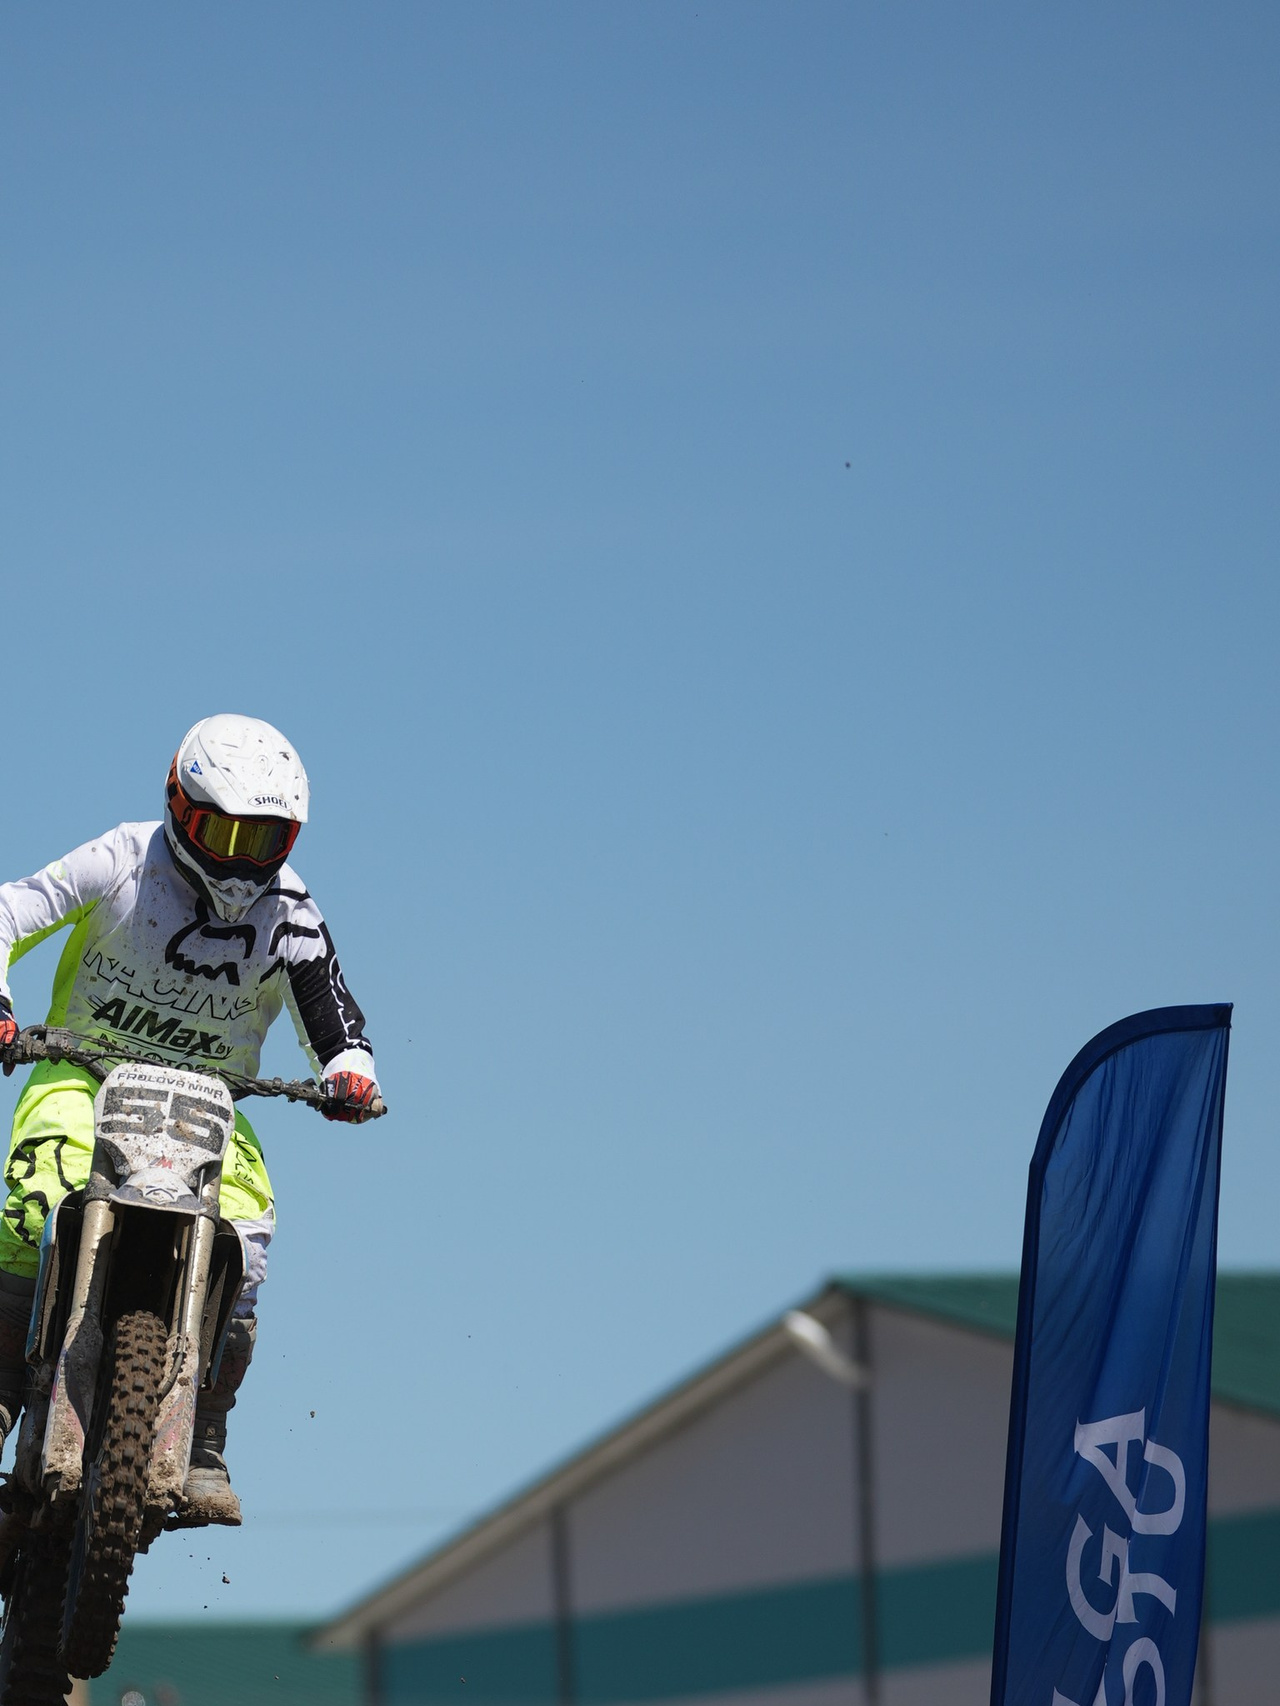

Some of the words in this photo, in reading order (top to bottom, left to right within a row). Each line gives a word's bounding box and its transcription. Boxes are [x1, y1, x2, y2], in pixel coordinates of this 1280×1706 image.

[254, 796, 288, 809] SHOEI
[215, 1042, 234, 1056] by
[117, 1072, 185, 1088] FROLOVA
[188, 1083, 224, 1100] NINA
[101, 1086, 231, 1155] 55
